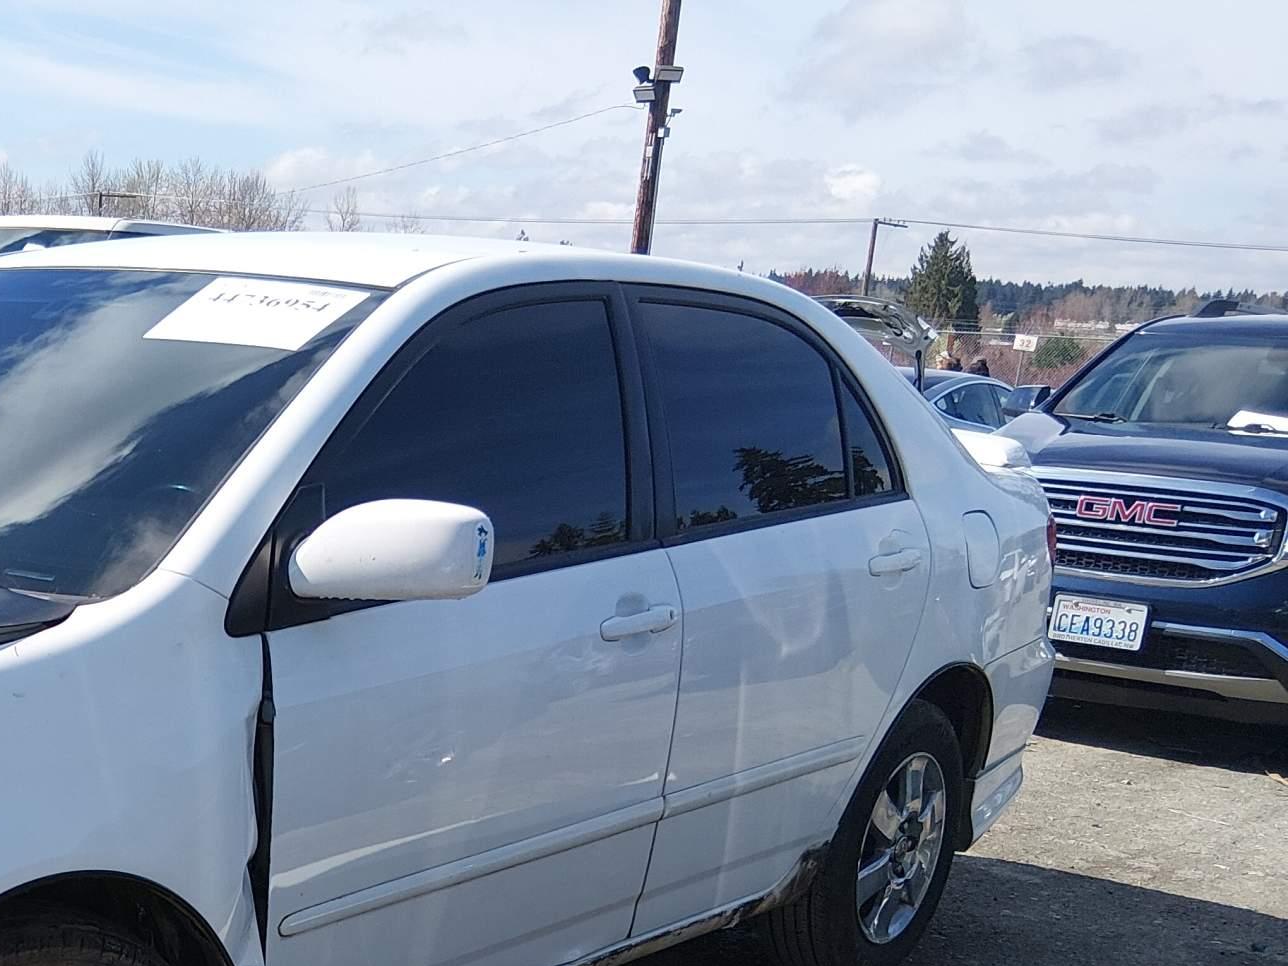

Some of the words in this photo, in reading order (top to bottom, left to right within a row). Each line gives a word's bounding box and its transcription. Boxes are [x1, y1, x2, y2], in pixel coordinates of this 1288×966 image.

[1076, 495, 1181, 527] GMC
[1063, 603, 1112, 615] WASHINGTON
[1057, 612, 1139, 642] CEA9338
